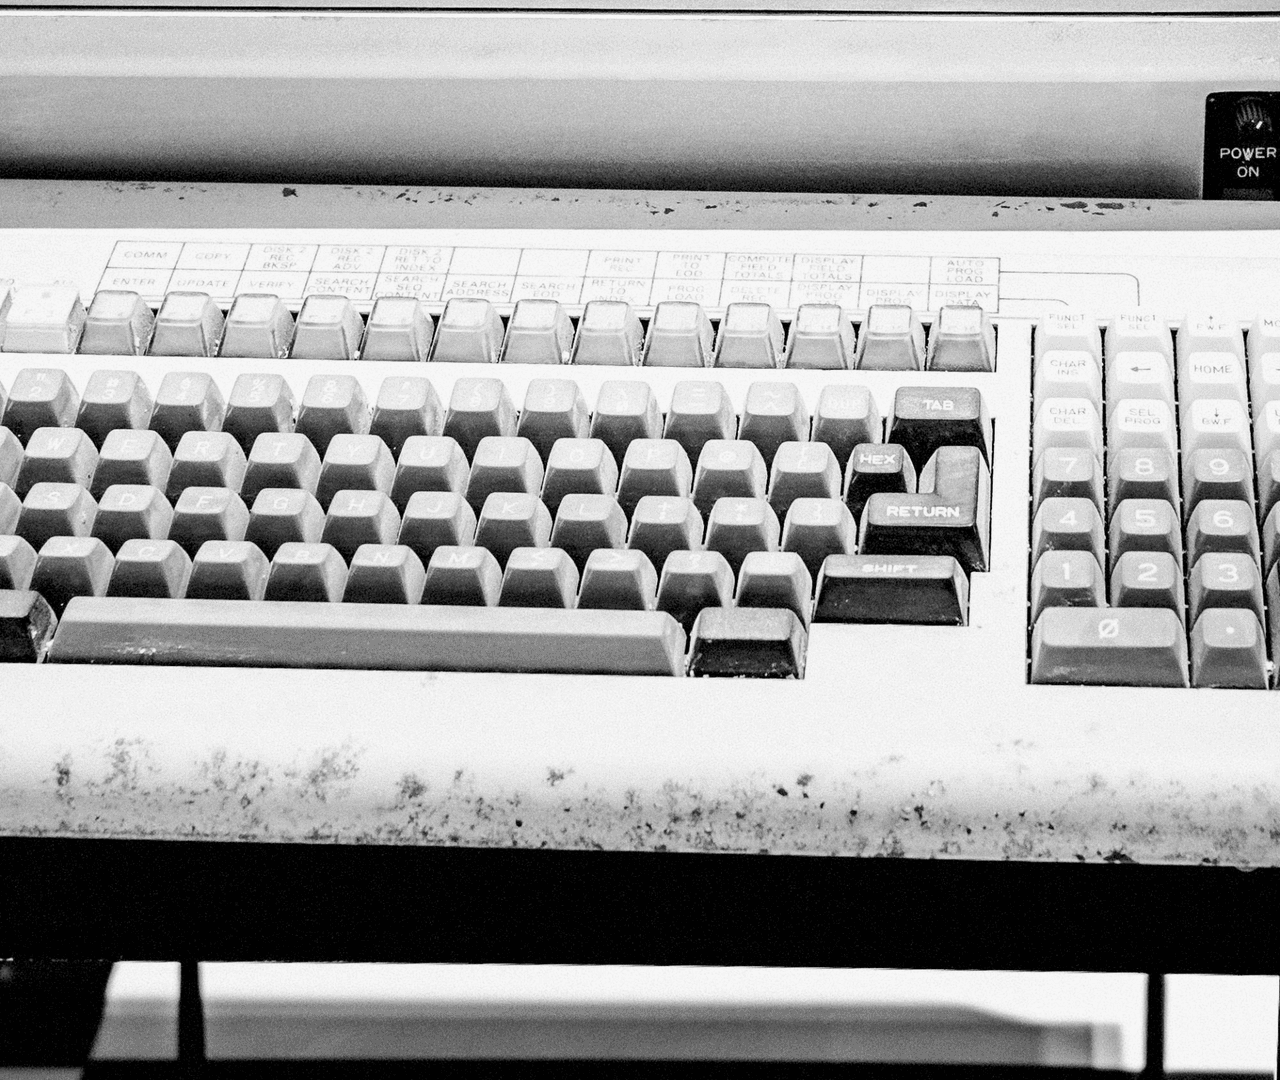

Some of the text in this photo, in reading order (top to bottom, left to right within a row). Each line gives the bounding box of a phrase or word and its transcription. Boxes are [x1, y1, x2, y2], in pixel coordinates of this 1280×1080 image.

[1220, 147, 1277, 160] POWER
[1237, 166, 1260, 178] ON
[124, 251, 168, 259] COMM
[263, 246, 295, 254] DISK
[331, 247, 362, 255] DISK
[195, 252, 231, 260] COPY
[337, 255, 361, 263] REC
[425, 256, 442, 264] TO
[604, 256, 641, 264] PRINT
[728, 255, 791, 263] COMPUTE
[801, 257, 855, 265] DISPLAY
[385, 275, 439, 283] SEARCH
[734, 271, 784, 280] TOTALS
[802, 273, 852, 281] TOTALS
[177, 279, 229, 288] UPDATE
[250, 280, 295, 289] VERIFY
[452, 281, 506, 289] SEARCH
[521, 282, 575, 290] SEARCH
[591, 279, 646, 287] RETURN
[797, 284, 853, 292] DISPLAY
[307, 285, 371, 294] CONTENT
[446, 288, 509, 296] ADDRESS
[668, 285, 704, 293] PROG
[866, 289, 922, 297] DISPLAY
[375, 291, 440, 300] CONTENT
[667, 293, 704, 301] LOAD
[934, 291, 991, 299] DISPLAY
[945, 299, 980, 307] DATA
[1049, 313, 1086, 321] FUNCT
[1049, 359, 1087, 368] CHAR
[1193, 364, 1233, 374] HOME
[1057, 368, 1079, 376] INS
[28, 386, 42, 398] 2
[103, 389, 117, 400] 3
[397, 394, 410, 405] 7
[923, 400, 955, 411] TAB
[1049, 407, 1087, 415] CHAR
[1129, 408, 1155, 417] SEL
[1053, 416, 1080, 425] DEL
[1124, 416, 1161, 425] PROG
[46, 437, 68, 450] W
[122, 439, 137, 452] E
[193, 440, 211, 455] R
[272, 442, 288, 456] T
[346, 443, 362, 458] Y
[421, 446, 437, 460] U
[569, 448, 584, 462] O
[645, 448, 661, 463] P
[859, 454, 896, 465] HEX
[1059, 457, 1078, 475] 7
[1135, 458, 1154, 476] 8
[1208, 458, 1230, 476] 9
[44, 492, 61, 504] S
[119, 493, 136, 506] D
[195, 495, 213, 508] F
[272, 496, 289, 510] G
[347, 498, 366, 512] H
[425, 500, 444, 514] J
[501, 501, 520, 515] K
[886, 505, 960, 518] RETURN
[1058, 509, 1078, 527] 4
[1135, 510, 1157, 528] 5
[1213, 510, 1235, 529] 6
[138, 545, 157, 558] C
[219, 547, 235, 559] V
[373, 550, 390, 563] N
[447, 552, 470, 565] M
[862, 563, 919, 573] SHIFT
[1061, 563, 1073, 582] 1
[1137, 563, 1159, 582] 2
[1218, 564, 1240, 583] 3
